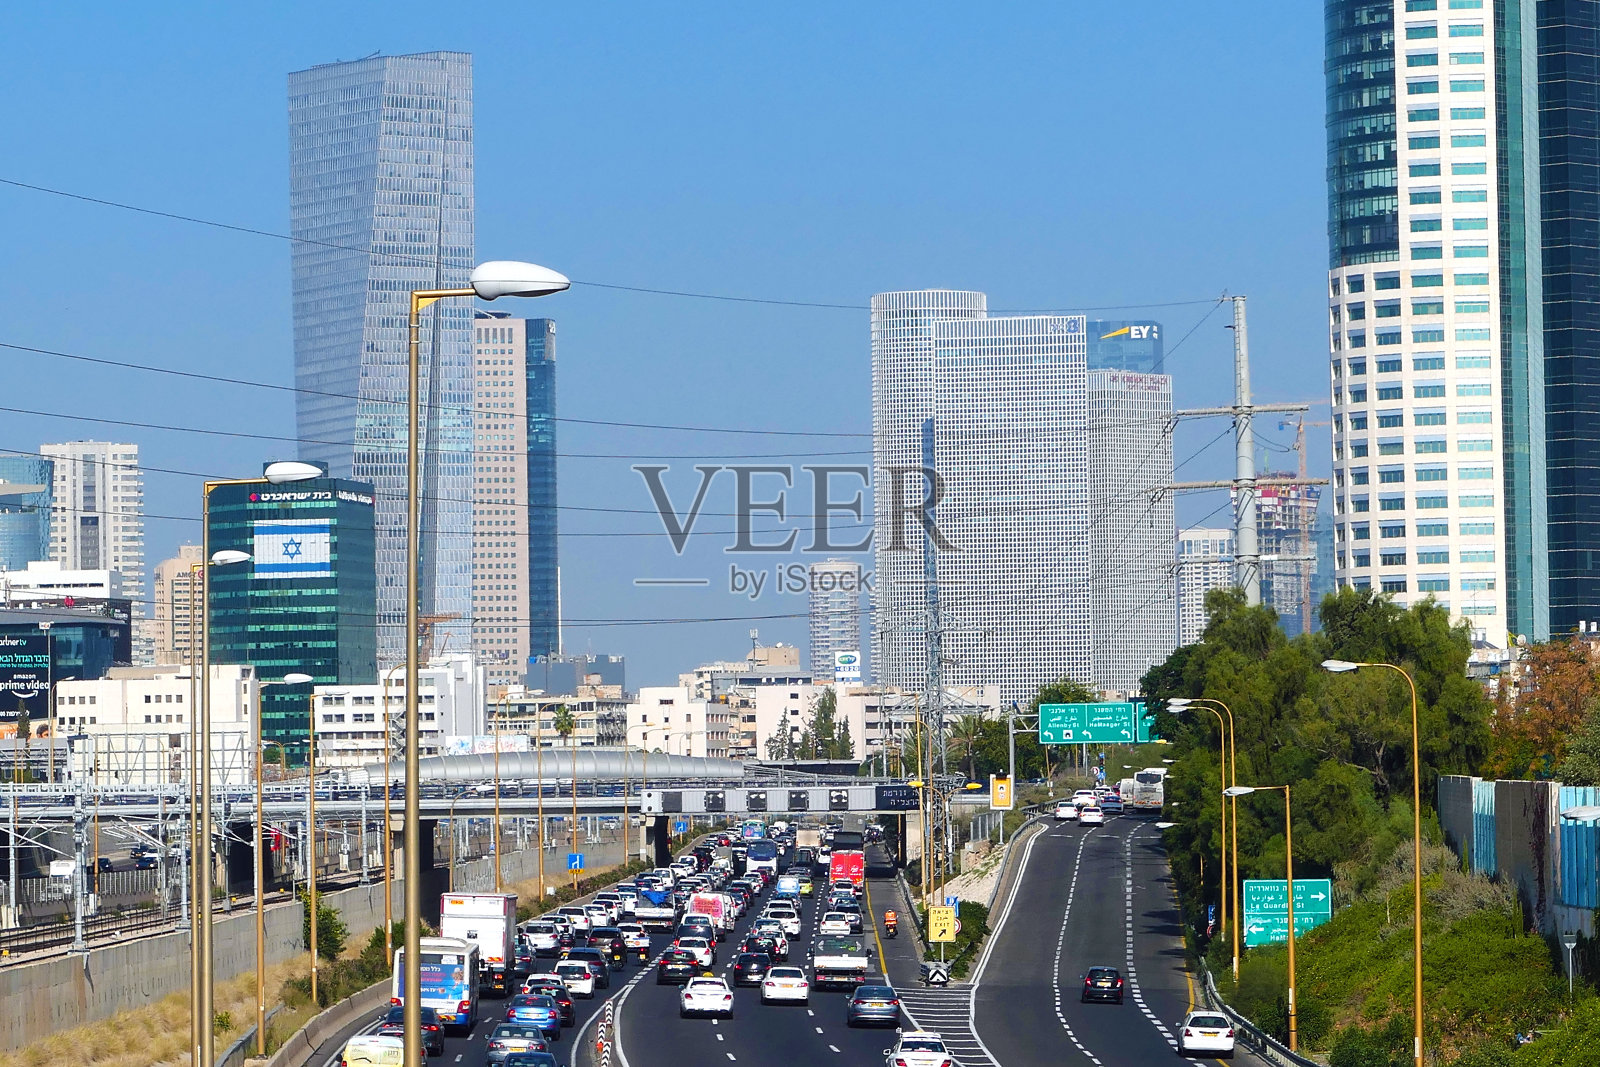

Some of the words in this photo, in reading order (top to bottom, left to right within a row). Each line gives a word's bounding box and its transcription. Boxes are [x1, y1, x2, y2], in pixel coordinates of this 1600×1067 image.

[1130, 326, 1151, 339] EY
[260, 492, 311, 501] ישראכרט
[312, 491, 332, 500] בית
[0, 680, 26, 691] prime
[26, 680, 49, 690] video
